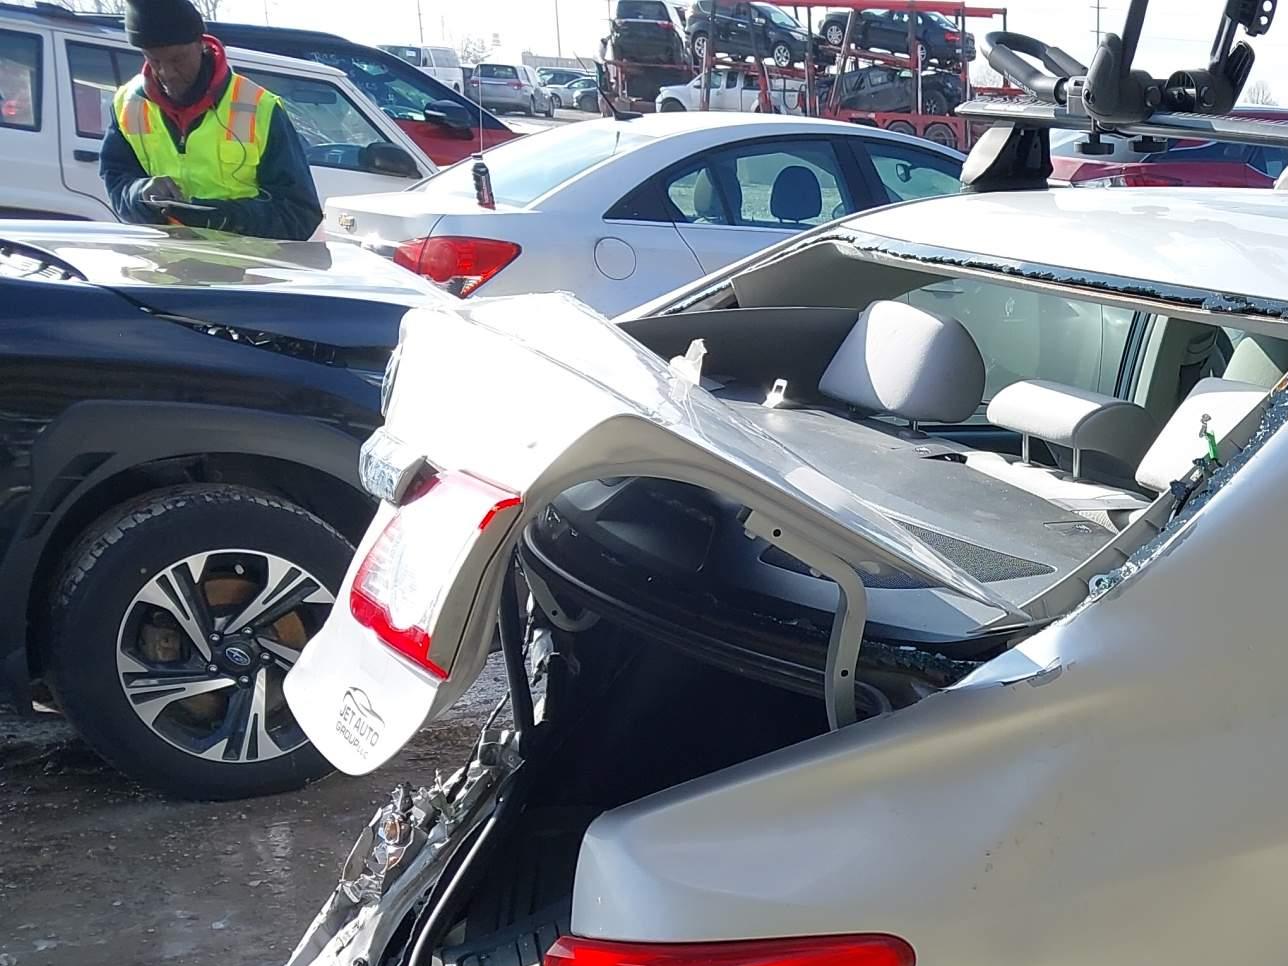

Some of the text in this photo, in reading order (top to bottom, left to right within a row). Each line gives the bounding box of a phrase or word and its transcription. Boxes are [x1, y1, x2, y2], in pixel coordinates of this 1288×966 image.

[335, 720, 361, 747] GROUP
[339, 703, 380, 747] JET AUTO
